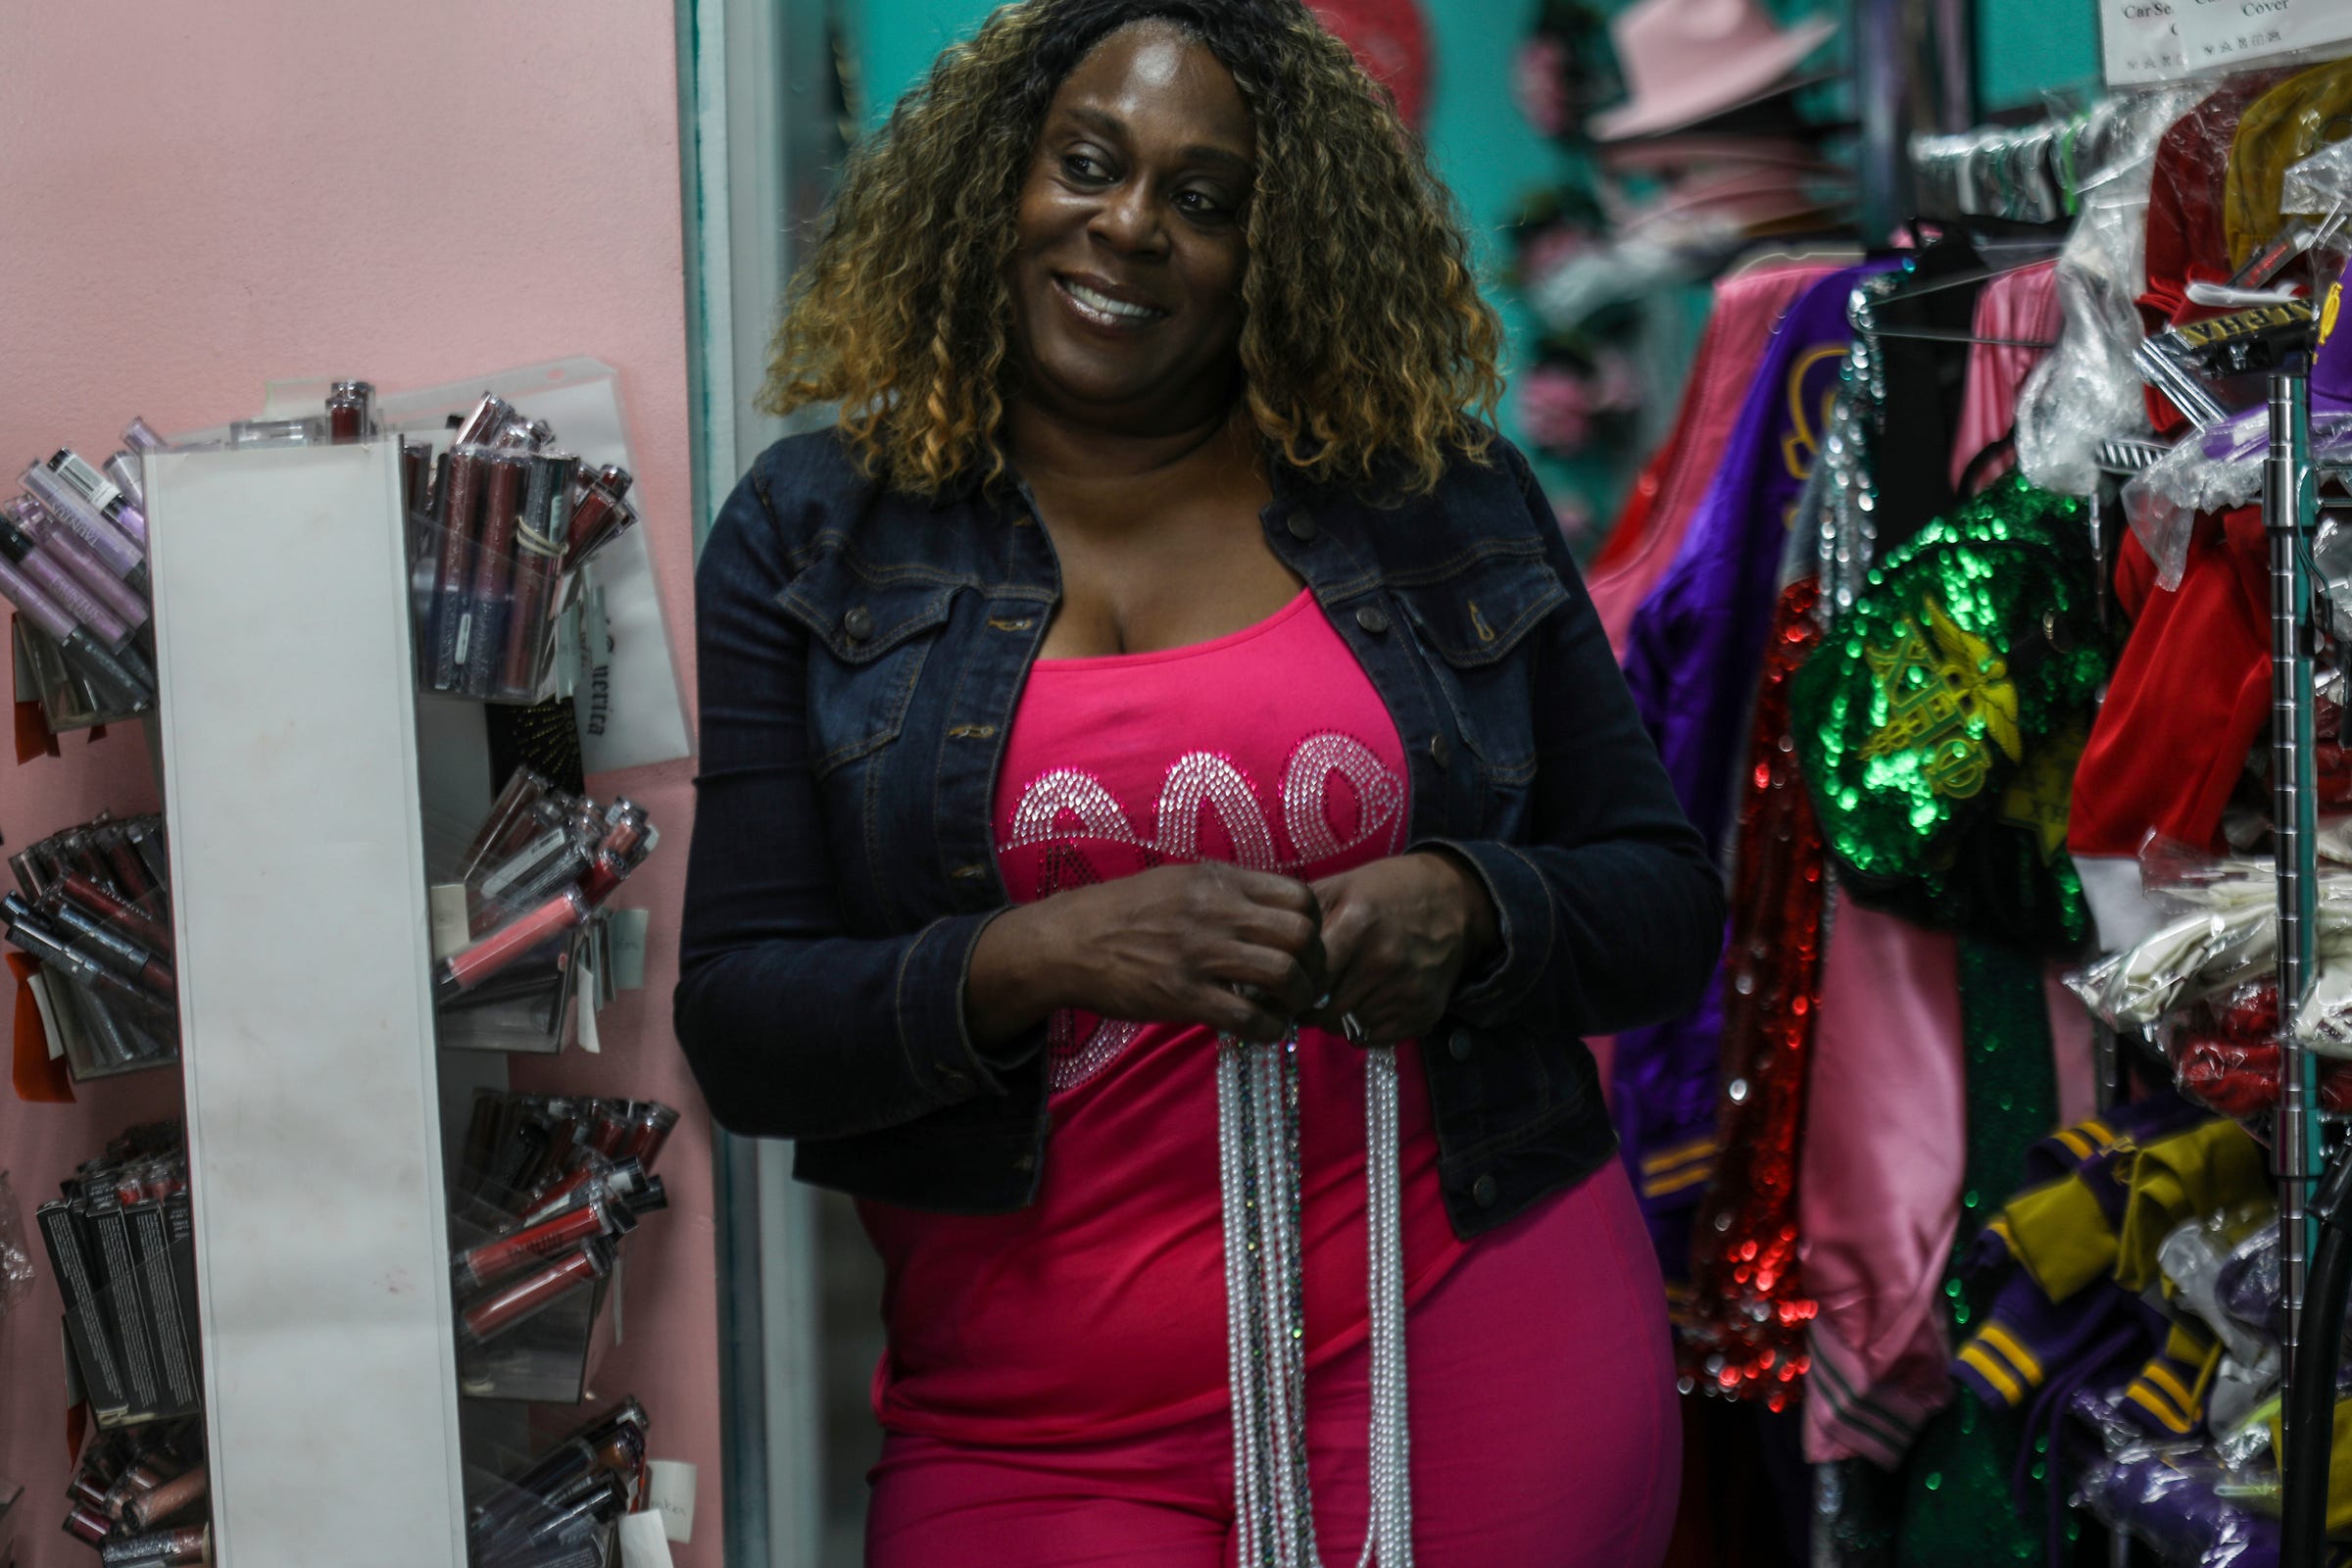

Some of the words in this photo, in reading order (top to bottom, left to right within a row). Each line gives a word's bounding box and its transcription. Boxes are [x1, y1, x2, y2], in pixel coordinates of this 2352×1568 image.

[2124, 5, 2151, 20] Car
[2154, 3, 2174, 16] Se
[2242, 0, 2288, 17] Cover
